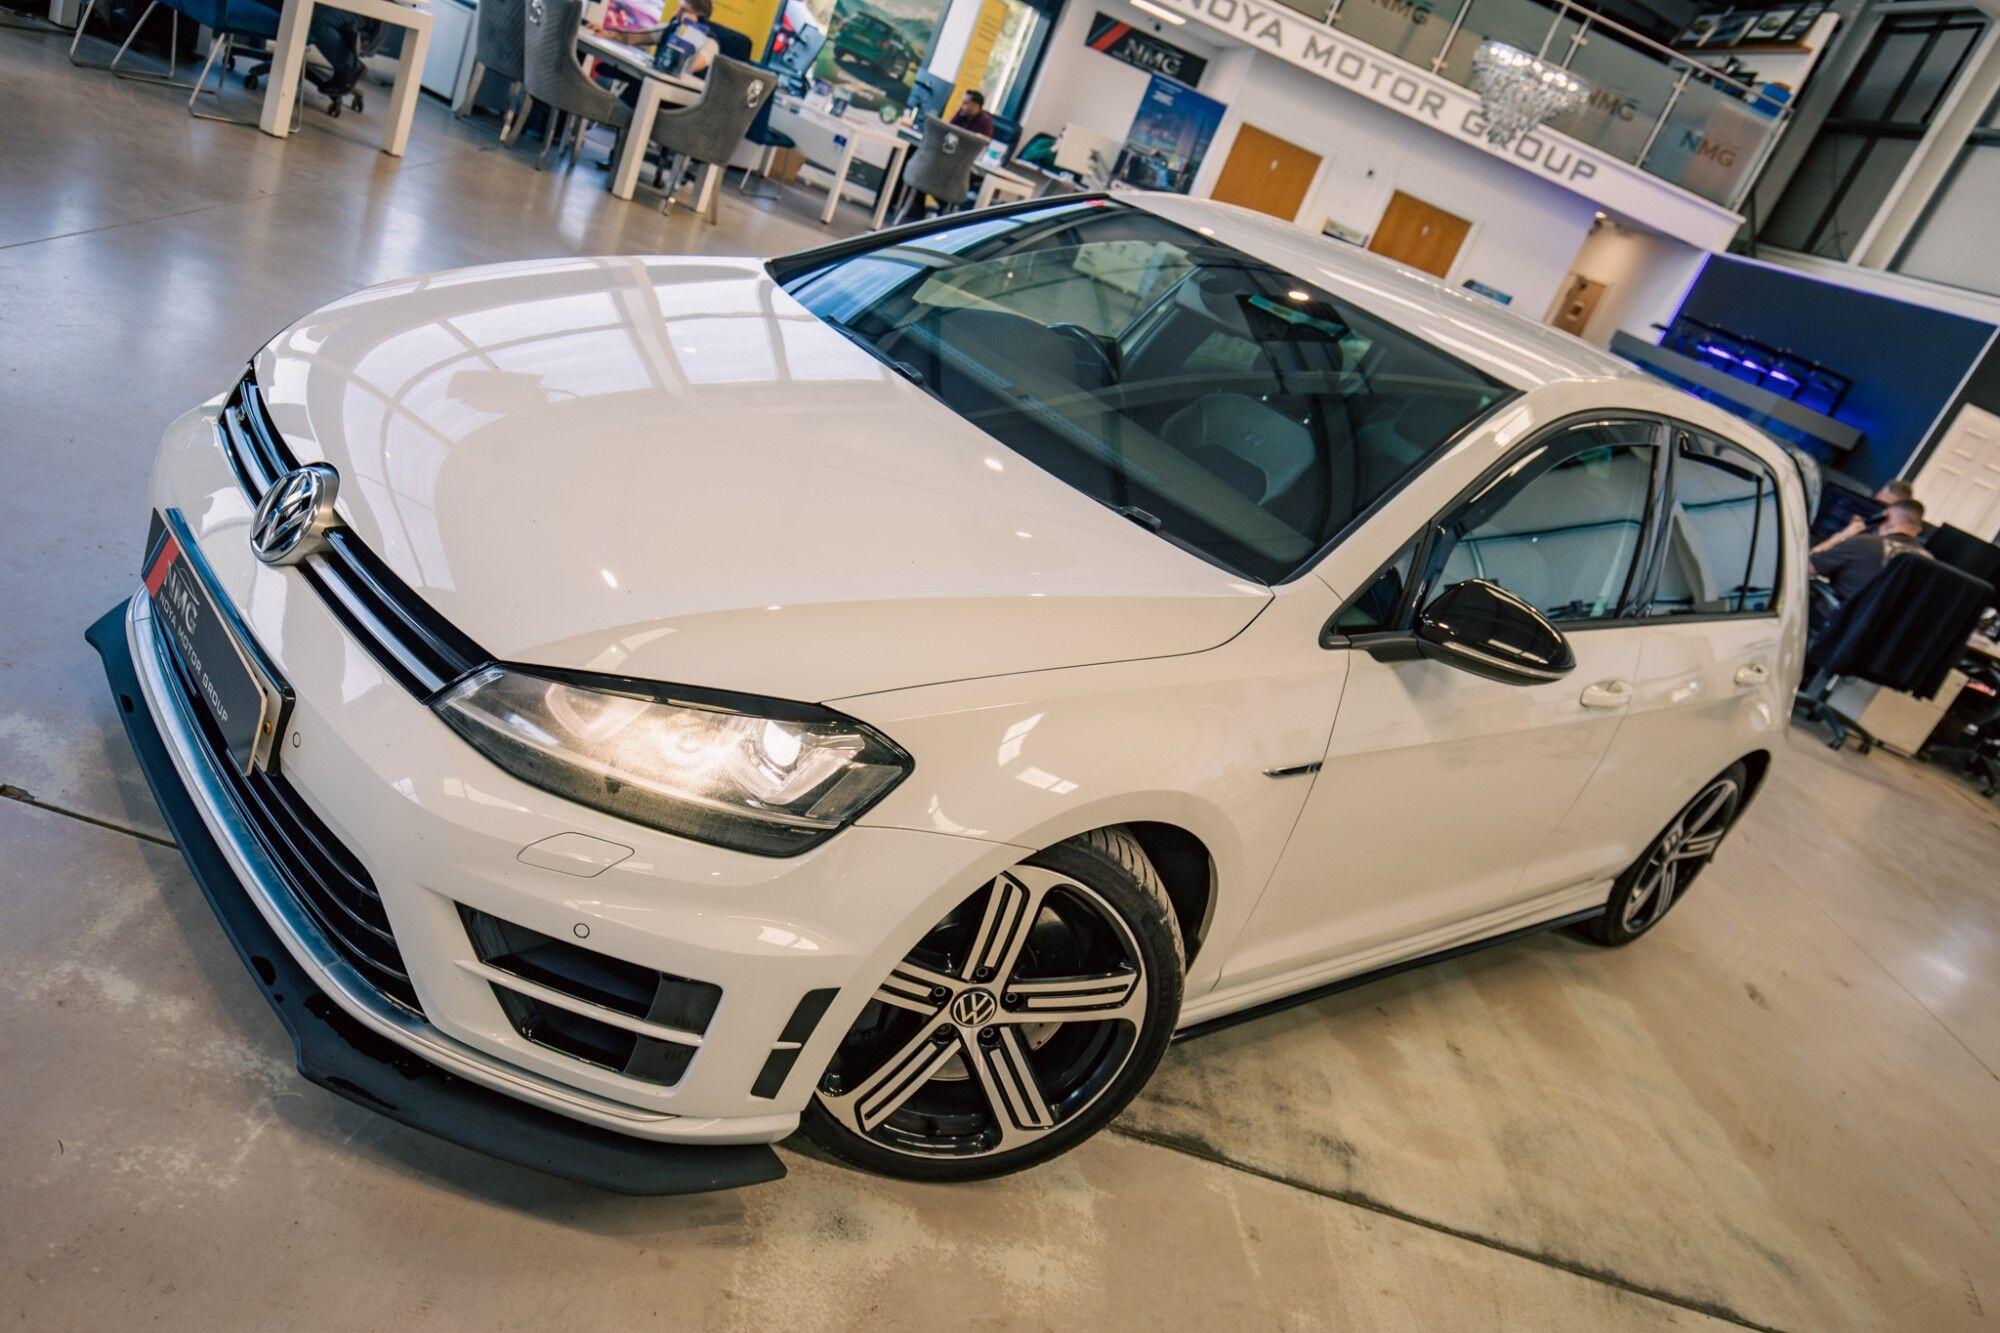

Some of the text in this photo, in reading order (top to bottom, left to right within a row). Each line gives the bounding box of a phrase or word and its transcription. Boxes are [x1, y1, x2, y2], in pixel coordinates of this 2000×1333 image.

[1124, 38, 1181, 75] NMG
[1302, 34, 1446, 119] MOTOR
[1680, 130, 1736, 167] NMG
[164, 560, 198, 635] NMG
[178, 625, 202, 675] MOTOR
[202, 673, 229, 722] GROUP
